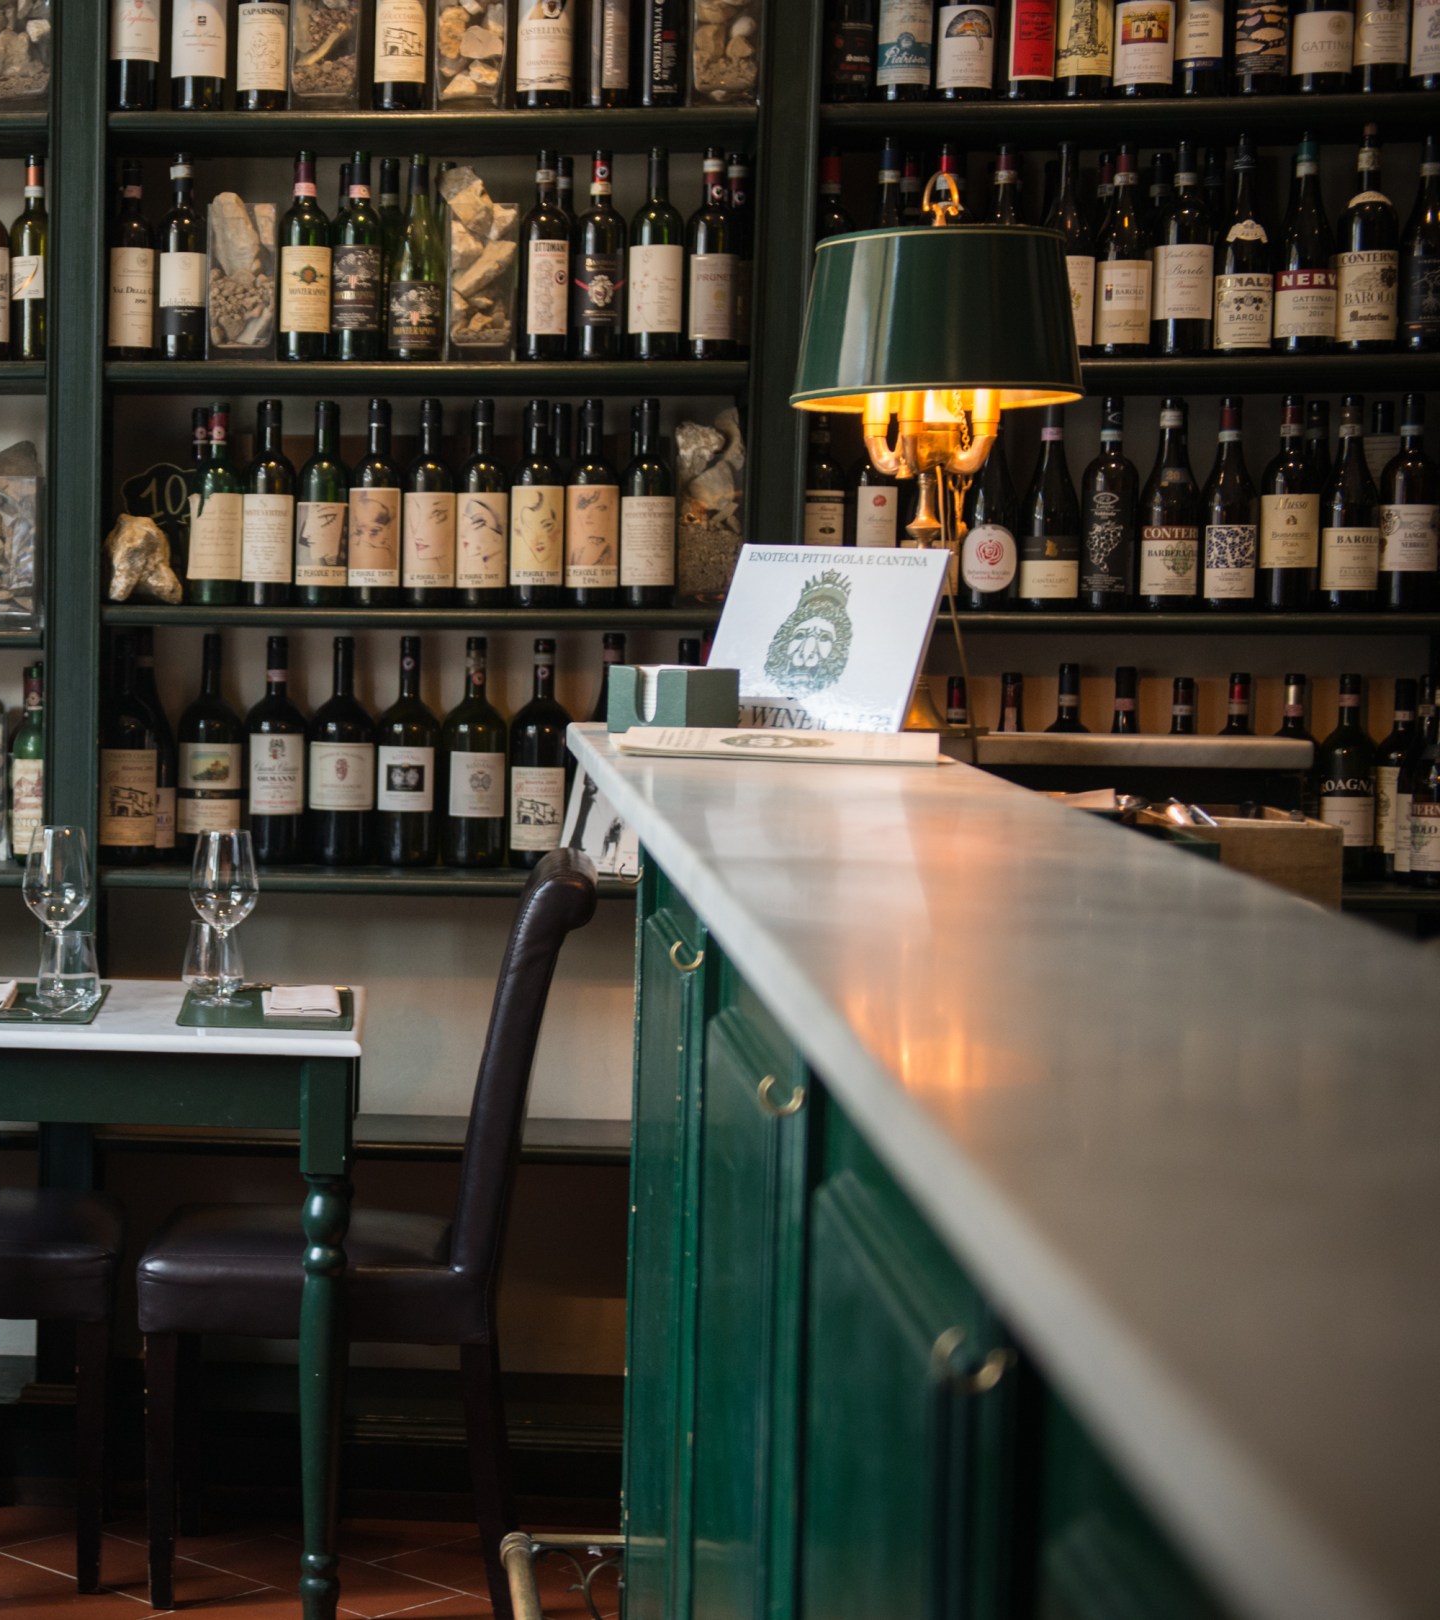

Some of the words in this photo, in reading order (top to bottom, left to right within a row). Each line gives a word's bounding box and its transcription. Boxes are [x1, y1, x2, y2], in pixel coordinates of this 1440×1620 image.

[1342, 252, 1395, 265] CONTERN
[1282, 273, 1337, 287] NERV
[1344, 293, 1395, 306] BAROLO
[1229, 314, 1265, 322] BAROLO
[140, 474, 188, 517] 10
[1144, 528, 1196, 539] CONTER
[749, 551, 799, 563] ENOTECA
[801, 552, 832, 564] PITTI
[832, 553, 864, 565] GOLA
[866, 554, 876, 566] E
[877, 555, 928, 568] CANTINA
[752, 705, 813, 730] WINE
